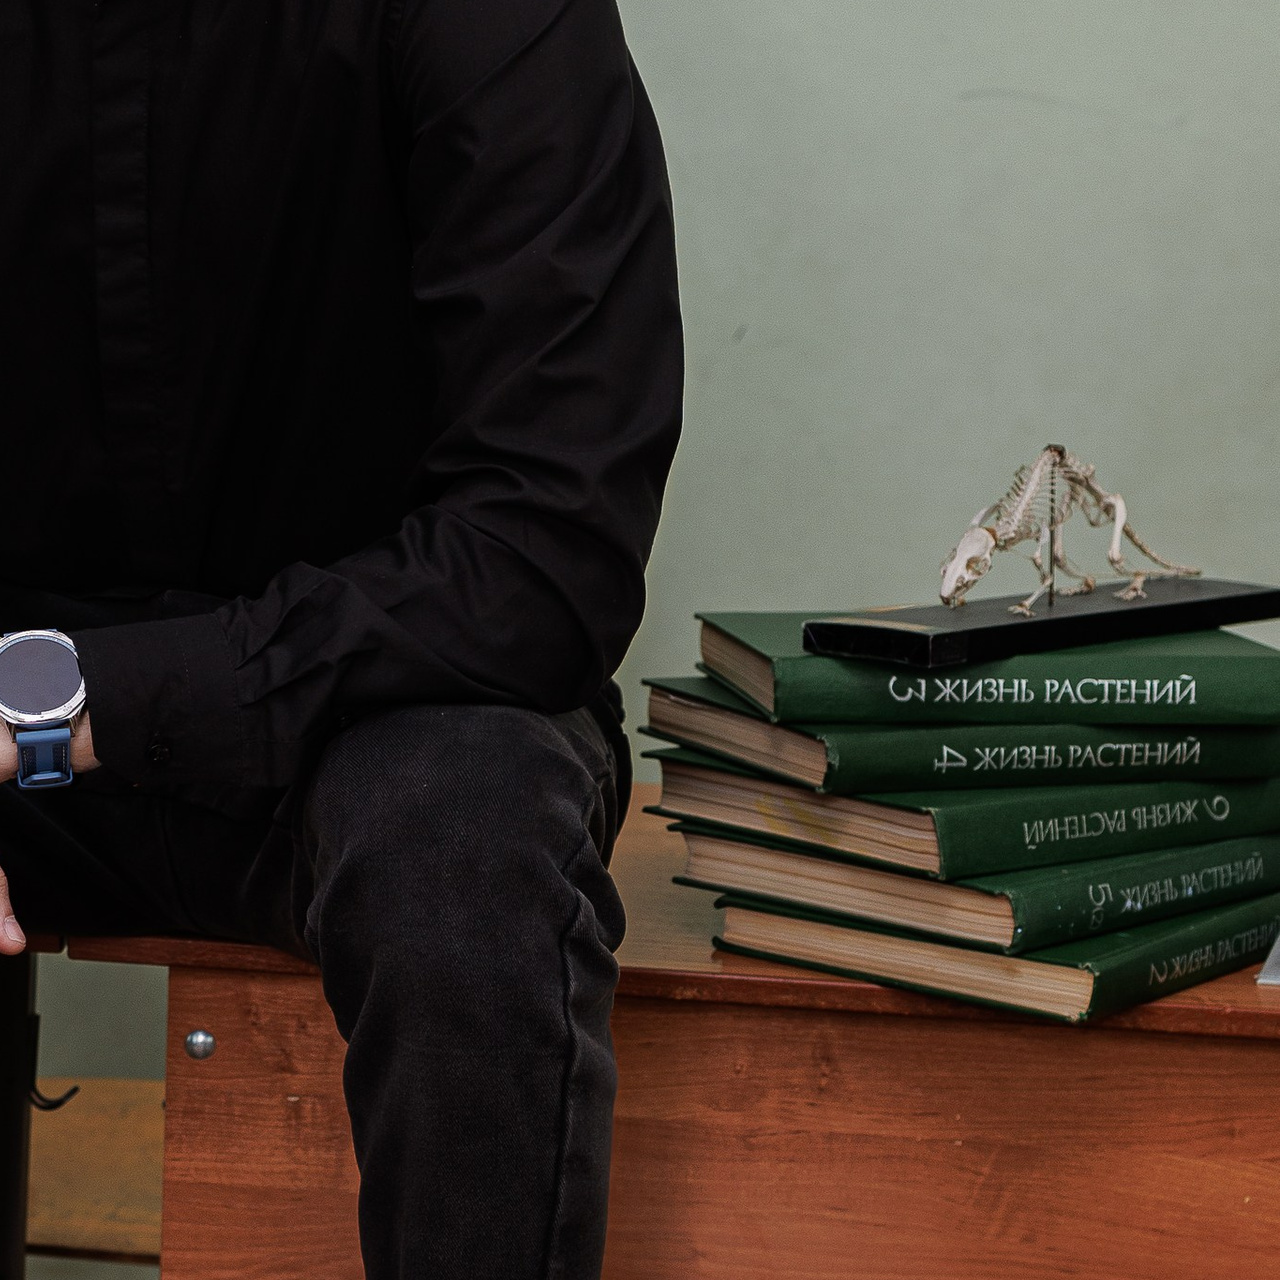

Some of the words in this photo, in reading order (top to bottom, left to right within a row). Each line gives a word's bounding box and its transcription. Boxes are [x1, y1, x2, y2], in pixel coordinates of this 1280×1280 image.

[933, 677, 1036, 705] ЖИЗНЬ
[1044, 673, 1198, 706] РАСТЕНИЙ
[973, 744, 1063, 772] ЖИЗНЬ
[1068, 735, 1203, 769] РАСТЕНИЙ
[1022, 808, 1128, 851] РАСТЕНИЙ
[1131, 798, 1200, 831] ЖИЗНЬ
[1119, 877, 1179, 914] ЖИЗНЬ
[1180, 851, 1265, 898] РАСТЕНИЙ
[1171, 943, 1215, 980] ЖИЗНЬ
